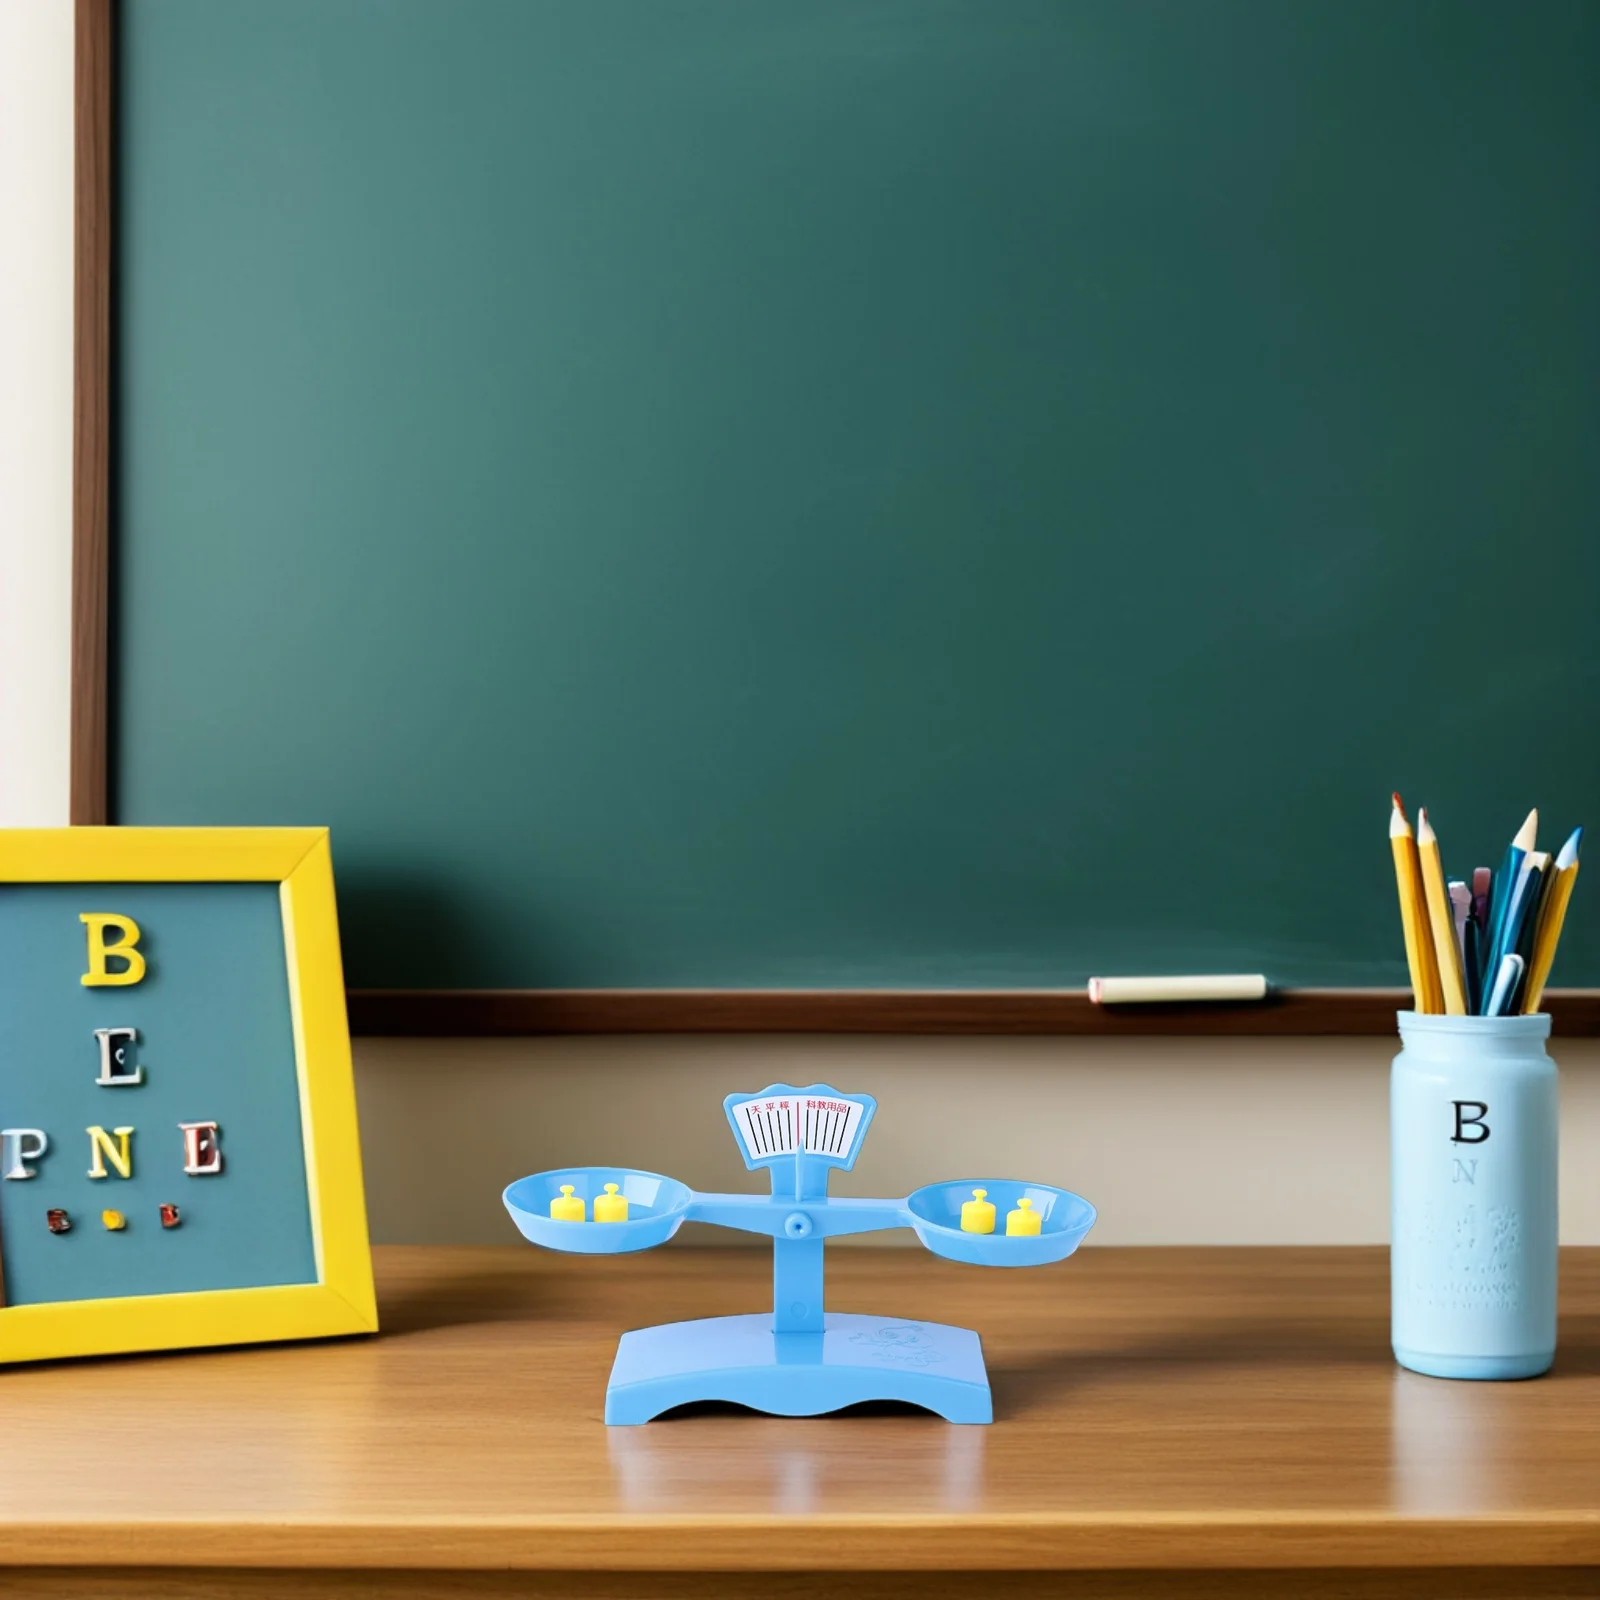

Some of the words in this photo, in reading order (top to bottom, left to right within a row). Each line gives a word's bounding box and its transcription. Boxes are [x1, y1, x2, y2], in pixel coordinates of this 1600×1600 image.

[79, 912, 146, 987] B
[93, 1027, 142, 1086] E
[806, 1099, 848, 1114] 科教用品
[1450, 1100, 1491, 1144] B
[86, 1126, 135, 1179] N
